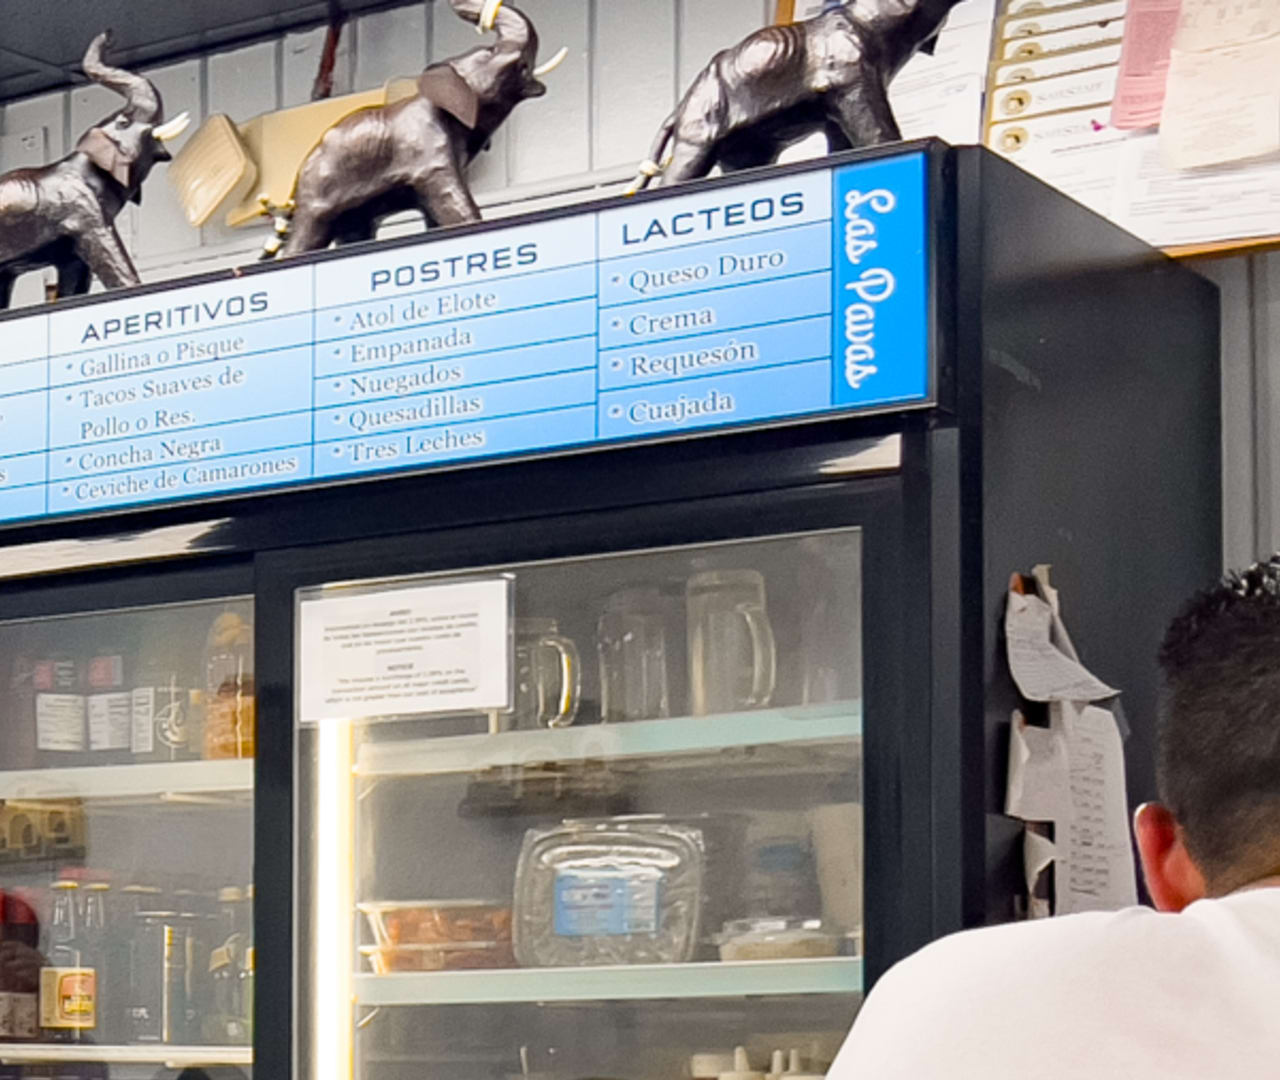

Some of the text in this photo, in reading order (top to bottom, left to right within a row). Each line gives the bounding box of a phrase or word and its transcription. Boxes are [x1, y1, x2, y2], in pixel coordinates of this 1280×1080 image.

[622, 191, 805, 246] LACTEOS
[370, 242, 539, 293] POSTRES
[628, 250, 785, 293] Queso Duro
[844, 188, 896, 389] Las Pavas
[80, 290, 270, 344] APERITIVOS
[349, 291, 497, 331] Atol de Elote
[628, 308, 713, 336] Crema
[79, 335, 245, 379] Gallina o Pisque
[350, 326, 472, 363] Empanada
[630, 339, 756, 378] Requesón
[78, 365, 245, 409] Tacos Suaves de
[349, 363, 463, 397] Nuegados
[348, 395, 482, 432] Quesadillas
[628, 390, 734, 424] Cuajada
[80, 415, 131, 440] Pollo
[135, 416, 149, 432] o
[347, 429, 484, 462] Tres Leches
[78, 437, 222, 472] Concha Negra
[74, 455, 297, 501] Ceviche de Camarones
